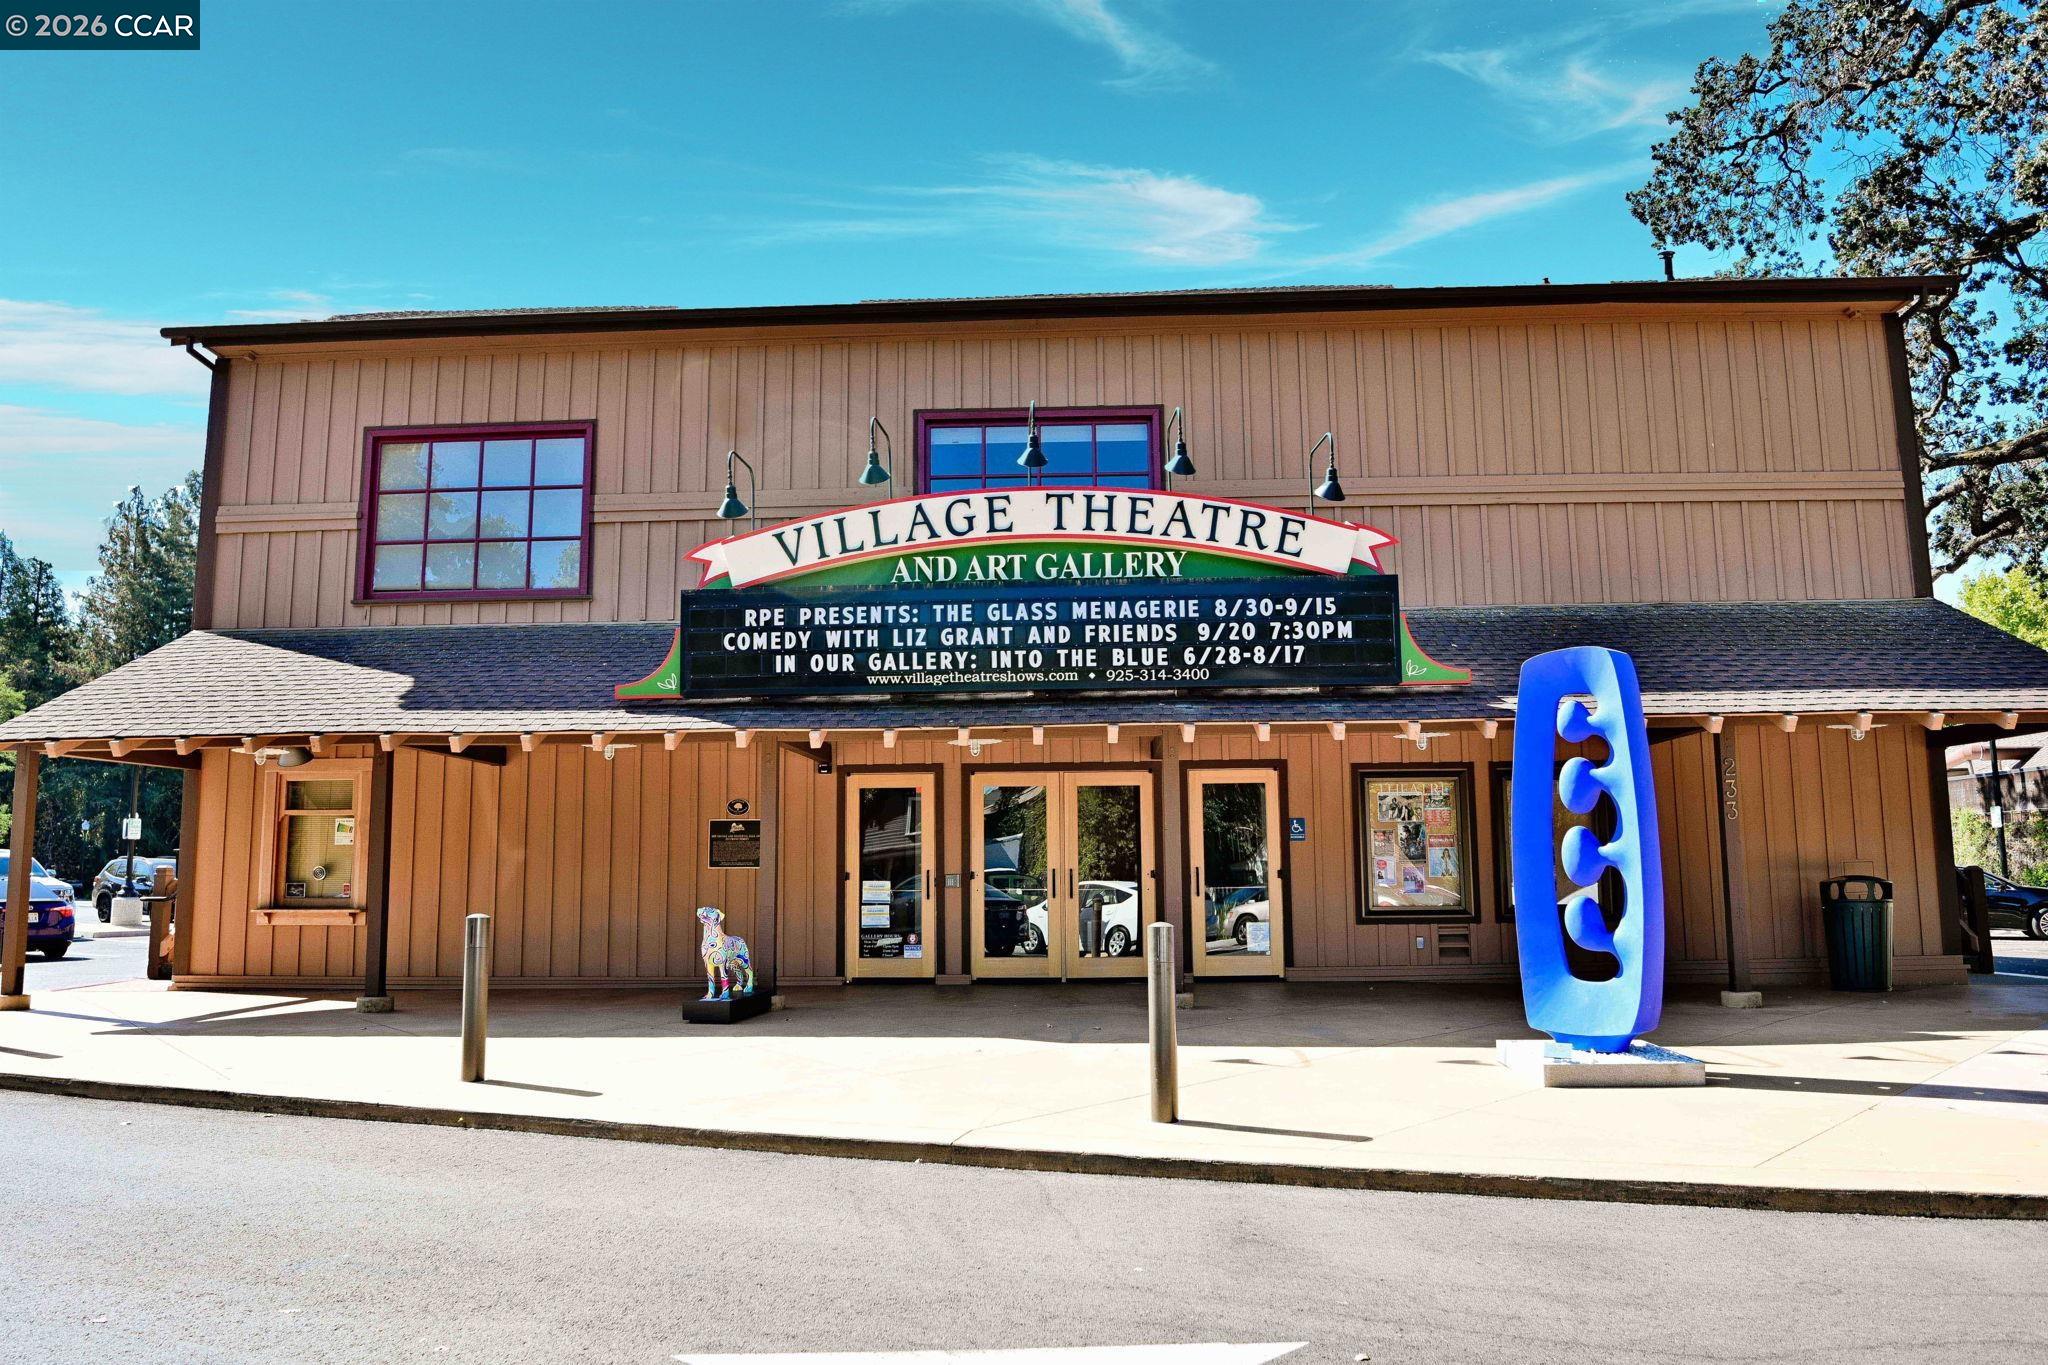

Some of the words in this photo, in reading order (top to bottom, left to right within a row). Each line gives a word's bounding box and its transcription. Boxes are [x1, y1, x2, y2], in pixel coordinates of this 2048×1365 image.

[772, 494, 1013, 567] VILLAGE
[1045, 492, 1306, 558] THEATRE
[890, 555, 957, 583] AND
[966, 554, 1027, 580] ART
[1035, 551, 1187, 579] GALLERY
[744, 608, 785, 627] RPE
[799, 605, 919, 625] PRESENTS:
[933, 604, 973, 622] THE
[987, 602, 1057, 621] GLASS
[1072, 599, 1200, 619] MENAGERIE
[1214, 597, 1337, 617] 8/30-9/15
[723, 630, 812, 651] COMEDY
[826, 629, 879, 648] WITH
[893, 627, 927, 647] LIZ
[940, 626, 1014, 645] GRANT
[1028, 625, 1071, 644] AND
[1085, 623, 1178, 642] FRIENDS
[1197, 622, 1254, 641] 9/20
[1270, 621, 1353, 640] 7:30PM
[775, 654, 796, 673] IN
[810, 653, 854, 672] OUR
[868, 651, 977, 671] GALLERY:
[991, 650, 1043, 669] INTO
[1057, 649, 1097, 668] THE
[1112, 648, 1169, 667] BLUE
[1183, 645, 1305, 666] 6/28-8/17
[867, 671, 1078, 686] www.villagetheatreshows.com
[1106, 668, 1210, 682] 925-314-3400
[1724, 757, 1738, 820] 233
